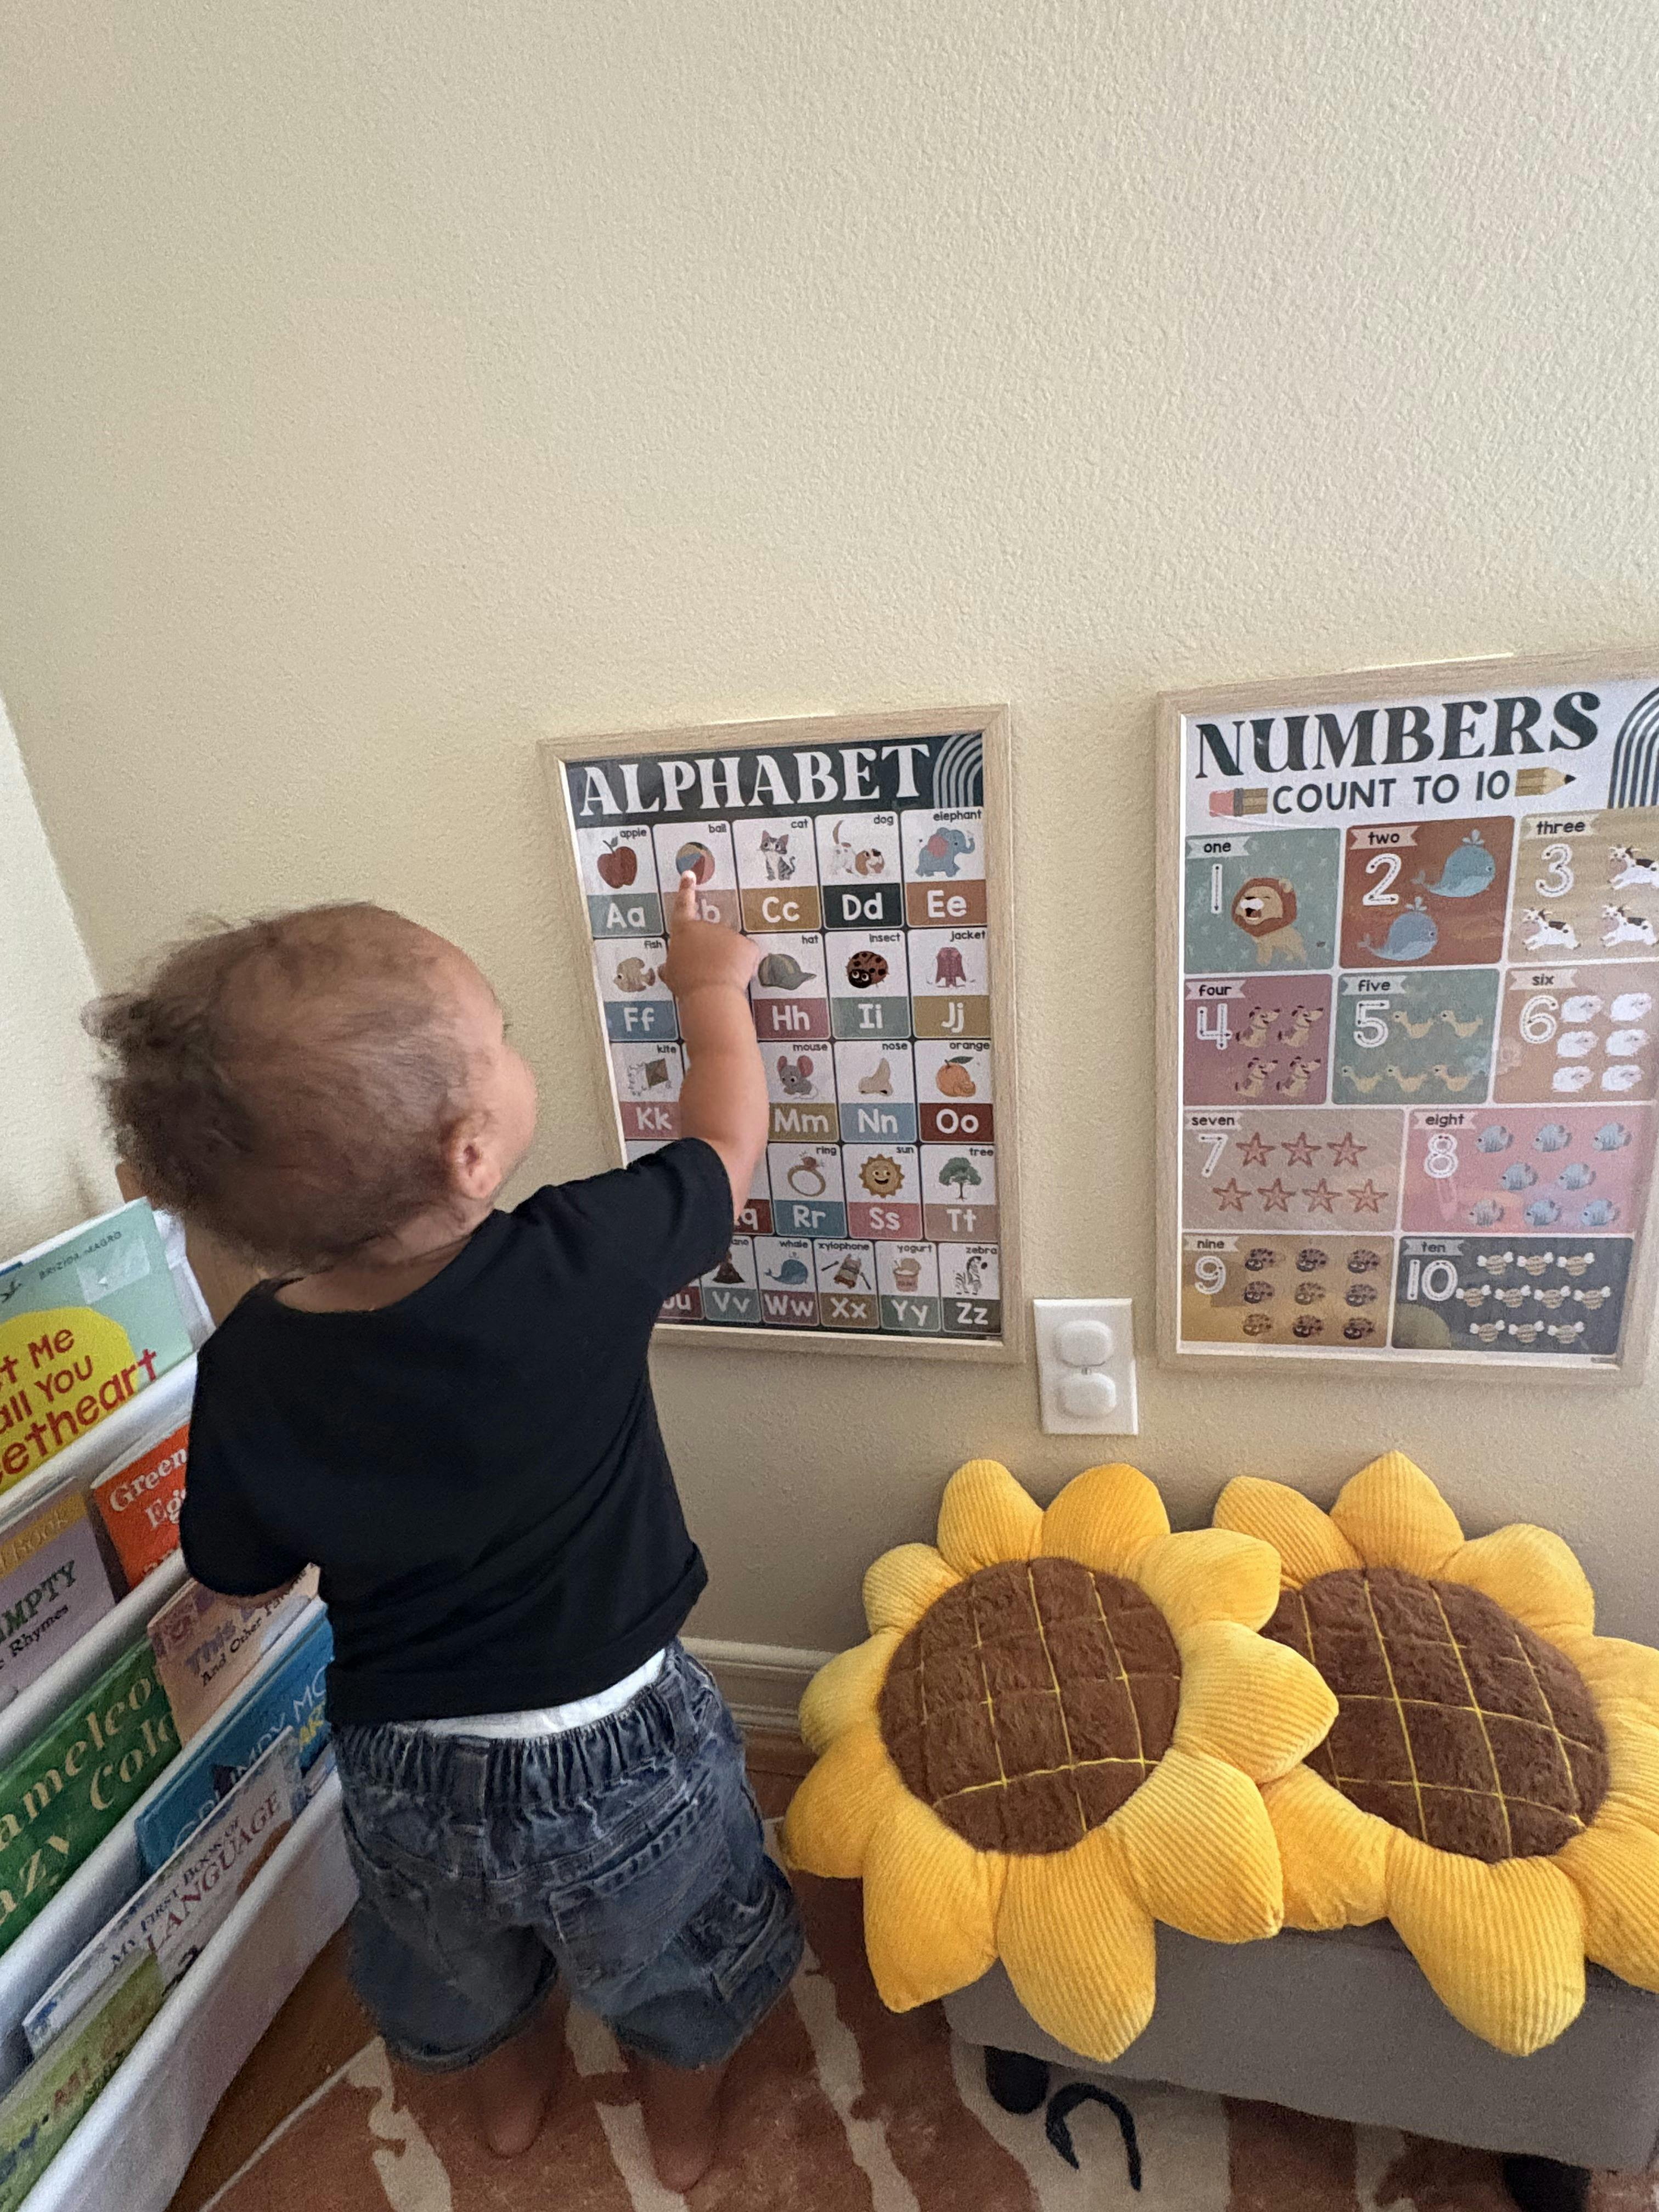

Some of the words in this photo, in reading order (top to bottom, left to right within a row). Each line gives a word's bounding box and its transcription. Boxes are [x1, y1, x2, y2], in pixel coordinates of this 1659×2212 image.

[1195, 691, 1601, 779] NUMBERS
[580, 744, 930, 816] ALPHABET
[1273, 778, 1396, 815] COUNT
[1413, 774, 1459, 804] TO
[1476, 770, 1510, 801] 10
[791, 819, 808, 829] cat
[873, 815, 894, 826] dog
[933, 809, 982, 822] elephant
[1536, 820, 1585, 834] three
[620, 828, 647, 840] apple
[708, 823, 726, 833] ball
[1368, 832, 1400, 845] two
[1204, 841, 1232, 853] one
[1363, 853, 1401, 906] 2
[1536, 843, 1574, 898] 3
[1211, 864, 1222, 914] 1
[606, 903, 645, 929] Aa
[693, 899, 720, 923] b
[762, 896, 800, 923] Cc
[842, 893, 883, 921] Dd
[927, 890, 967, 918] Ee
[802, 935, 819, 944] hat
[869, 934, 900, 943] insect
[950, 930, 986, 942] jacket
[1199, 984, 1232, 997] four
[1358, 980, 1391, 992] five
[1532, 974, 1555, 986] six
[623, 1007, 656, 1032] Ff
[772, 1005, 810, 1031] Hh
[858, 1003, 883, 1029] Ii
[941, 1002, 964, 1034] Jj
[1197, 1003, 1232, 1050] 4
[1353, 1000, 1390, 1048] 5
[1519, 994, 1559, 1045] 6
[657, 1045, 676, 1054] kite
[793, 1043, 827, 1052] mouse
[950, 1041, 990, 1051] orange
[636, 1107, 672, 1131] Kk
[775, 1109, 829, 1132] Mm
[857, 1109, 898, 1133] Nn
[936, 1109, 979, 1133] Oo
[1191, 1115, 1235, 1126] seven
[1425, 1114, 1465, 1127] eight
[816, 1147, 837, 1156] ring
[1198, 1133, 1228, 1177] 7
[1424, 1133, 1458, 1178] 8
[734, 1208, 759, 1231] q
[793, 1205, 826, 1229] Rr
[870, 1207, 900, 1231] Ss
[947, 1209, 977, 1232] Tt
[780, 1240, 808, 1248] whale
[818, 1242, 870, 1251] xylophone
[897, 1244, 932, 1254] yogurt
[966, 1246, 997, 1255] zebra
[1197, 1239, 1224, 1249] nine
[1422, 1242, 1446, 1254] ten
[1194, 1256, 1226, 1295] 9
[1407, 1259, 1458, 1301] 10
[713, 1291, 750, 1313] Vv
[764, 1293, 814, 1317] Ww
[830, 1297, 867, 1318] Xx
[891, 1299, 928, 1327] Yy
[956, 1302, 988, 1325] Zz
[27, 1329, 75, 1369] Me
[0, 1348, 156, 1484] etheart
[110, 1448, 187, 1511] Green
[0, 1560, 76, 1641] MPTY
[201, 1653, 227, 1687] And
[148, 1788, 280, 1952] LANGUAGE
